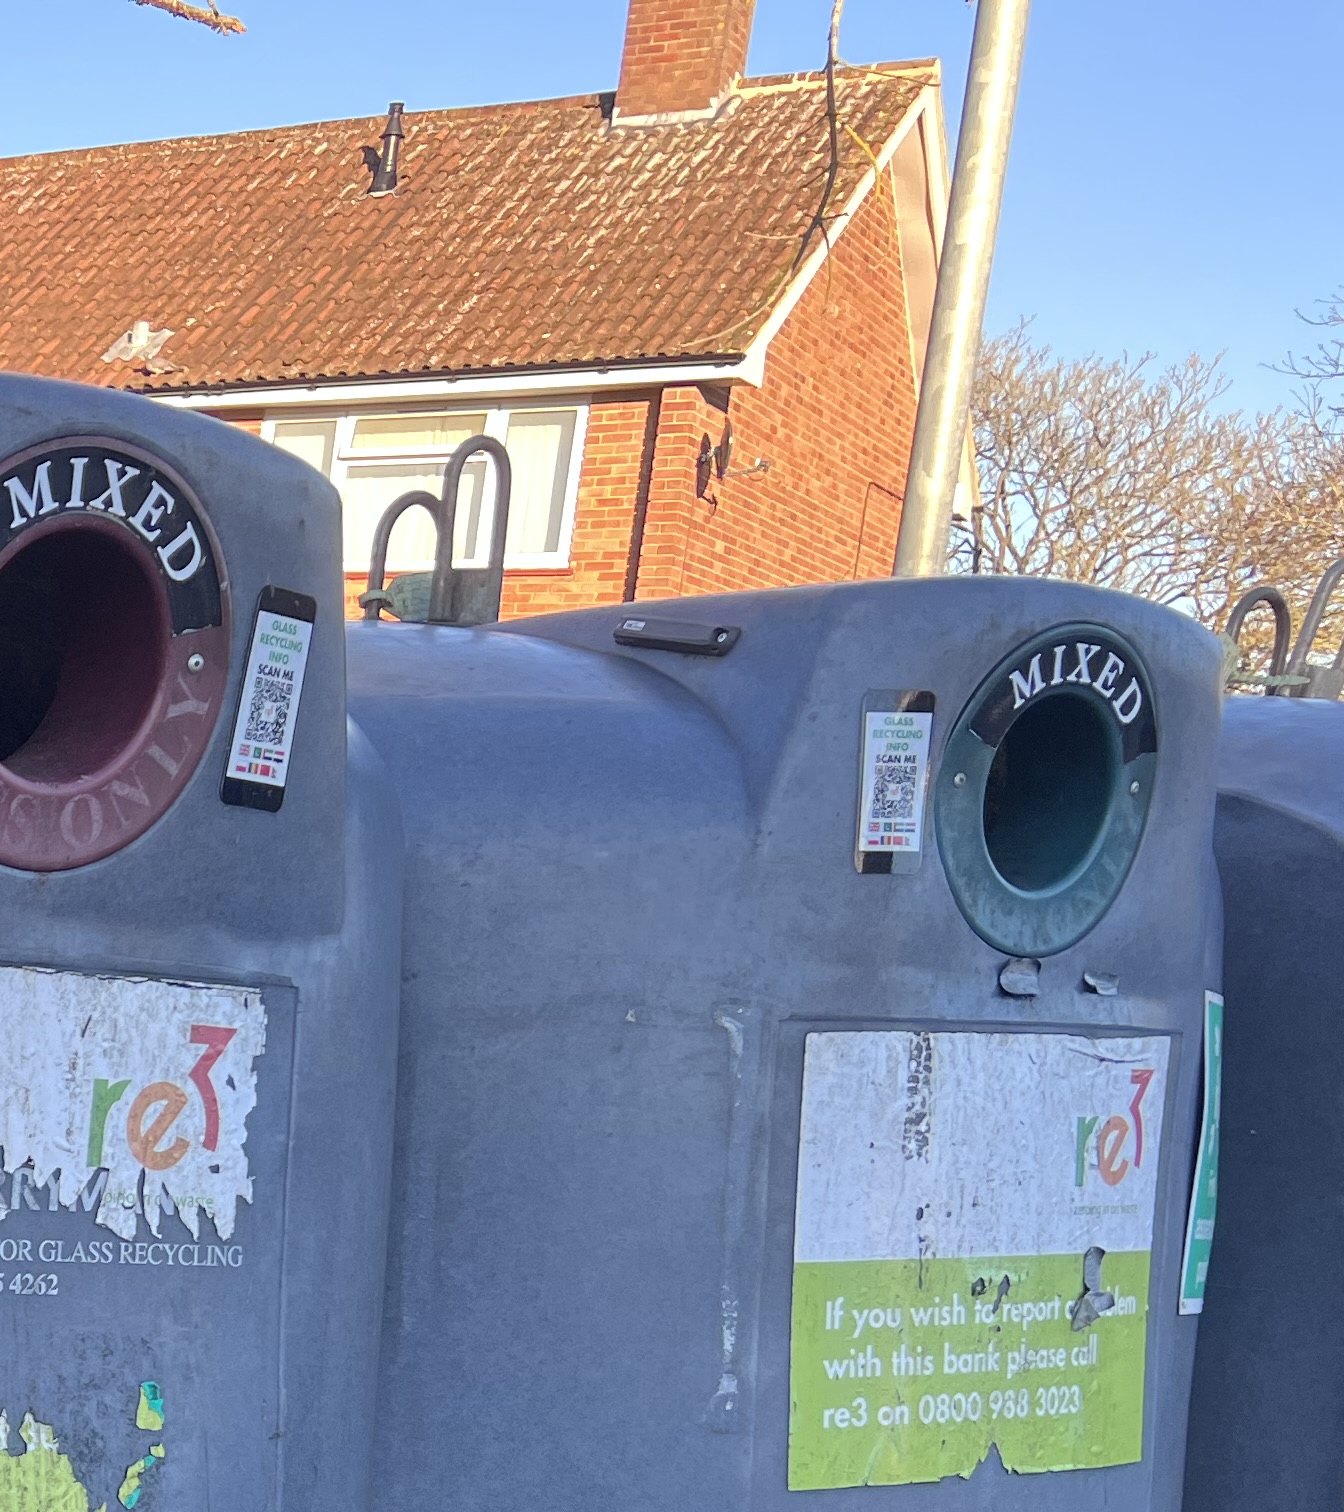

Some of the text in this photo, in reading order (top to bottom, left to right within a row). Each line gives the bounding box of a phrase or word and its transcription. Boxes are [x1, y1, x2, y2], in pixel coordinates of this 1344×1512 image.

[3, 456, 202, 581] MIXED
[259, 632, 303, 653] RECYCLING
[271, 619, 298, 636] GLASS
[257, 663, 295, 681] SCAN ME
[268, 650, 290, 666] INFO
[1009, 641, 1142, 724] MIXED
[60, 671, 211, 849] ONLY
[876, 754, 901, 764] SCAN
[87, 1023, 238, 1171] re3
[1075, 1068, 1155, 1188] re3
[38, 1240, 113, 1265] GLASS
[118, 1242, 244, 1268] RECYCLING
[8, 1273, 59, 1296] 4262
[824, 1297, 844, 1331] If
[851, 1308, 902, 1339] you
[910, 1292, 966, 1328] wish
[974, 1297, 996, 1324] to
[1002, 1297, 1061, 1331] report
[823, 1333, 1098, 1380] with this bank please call
[823, 1384, 1081, 1428] re3 on 0800 988 3023
